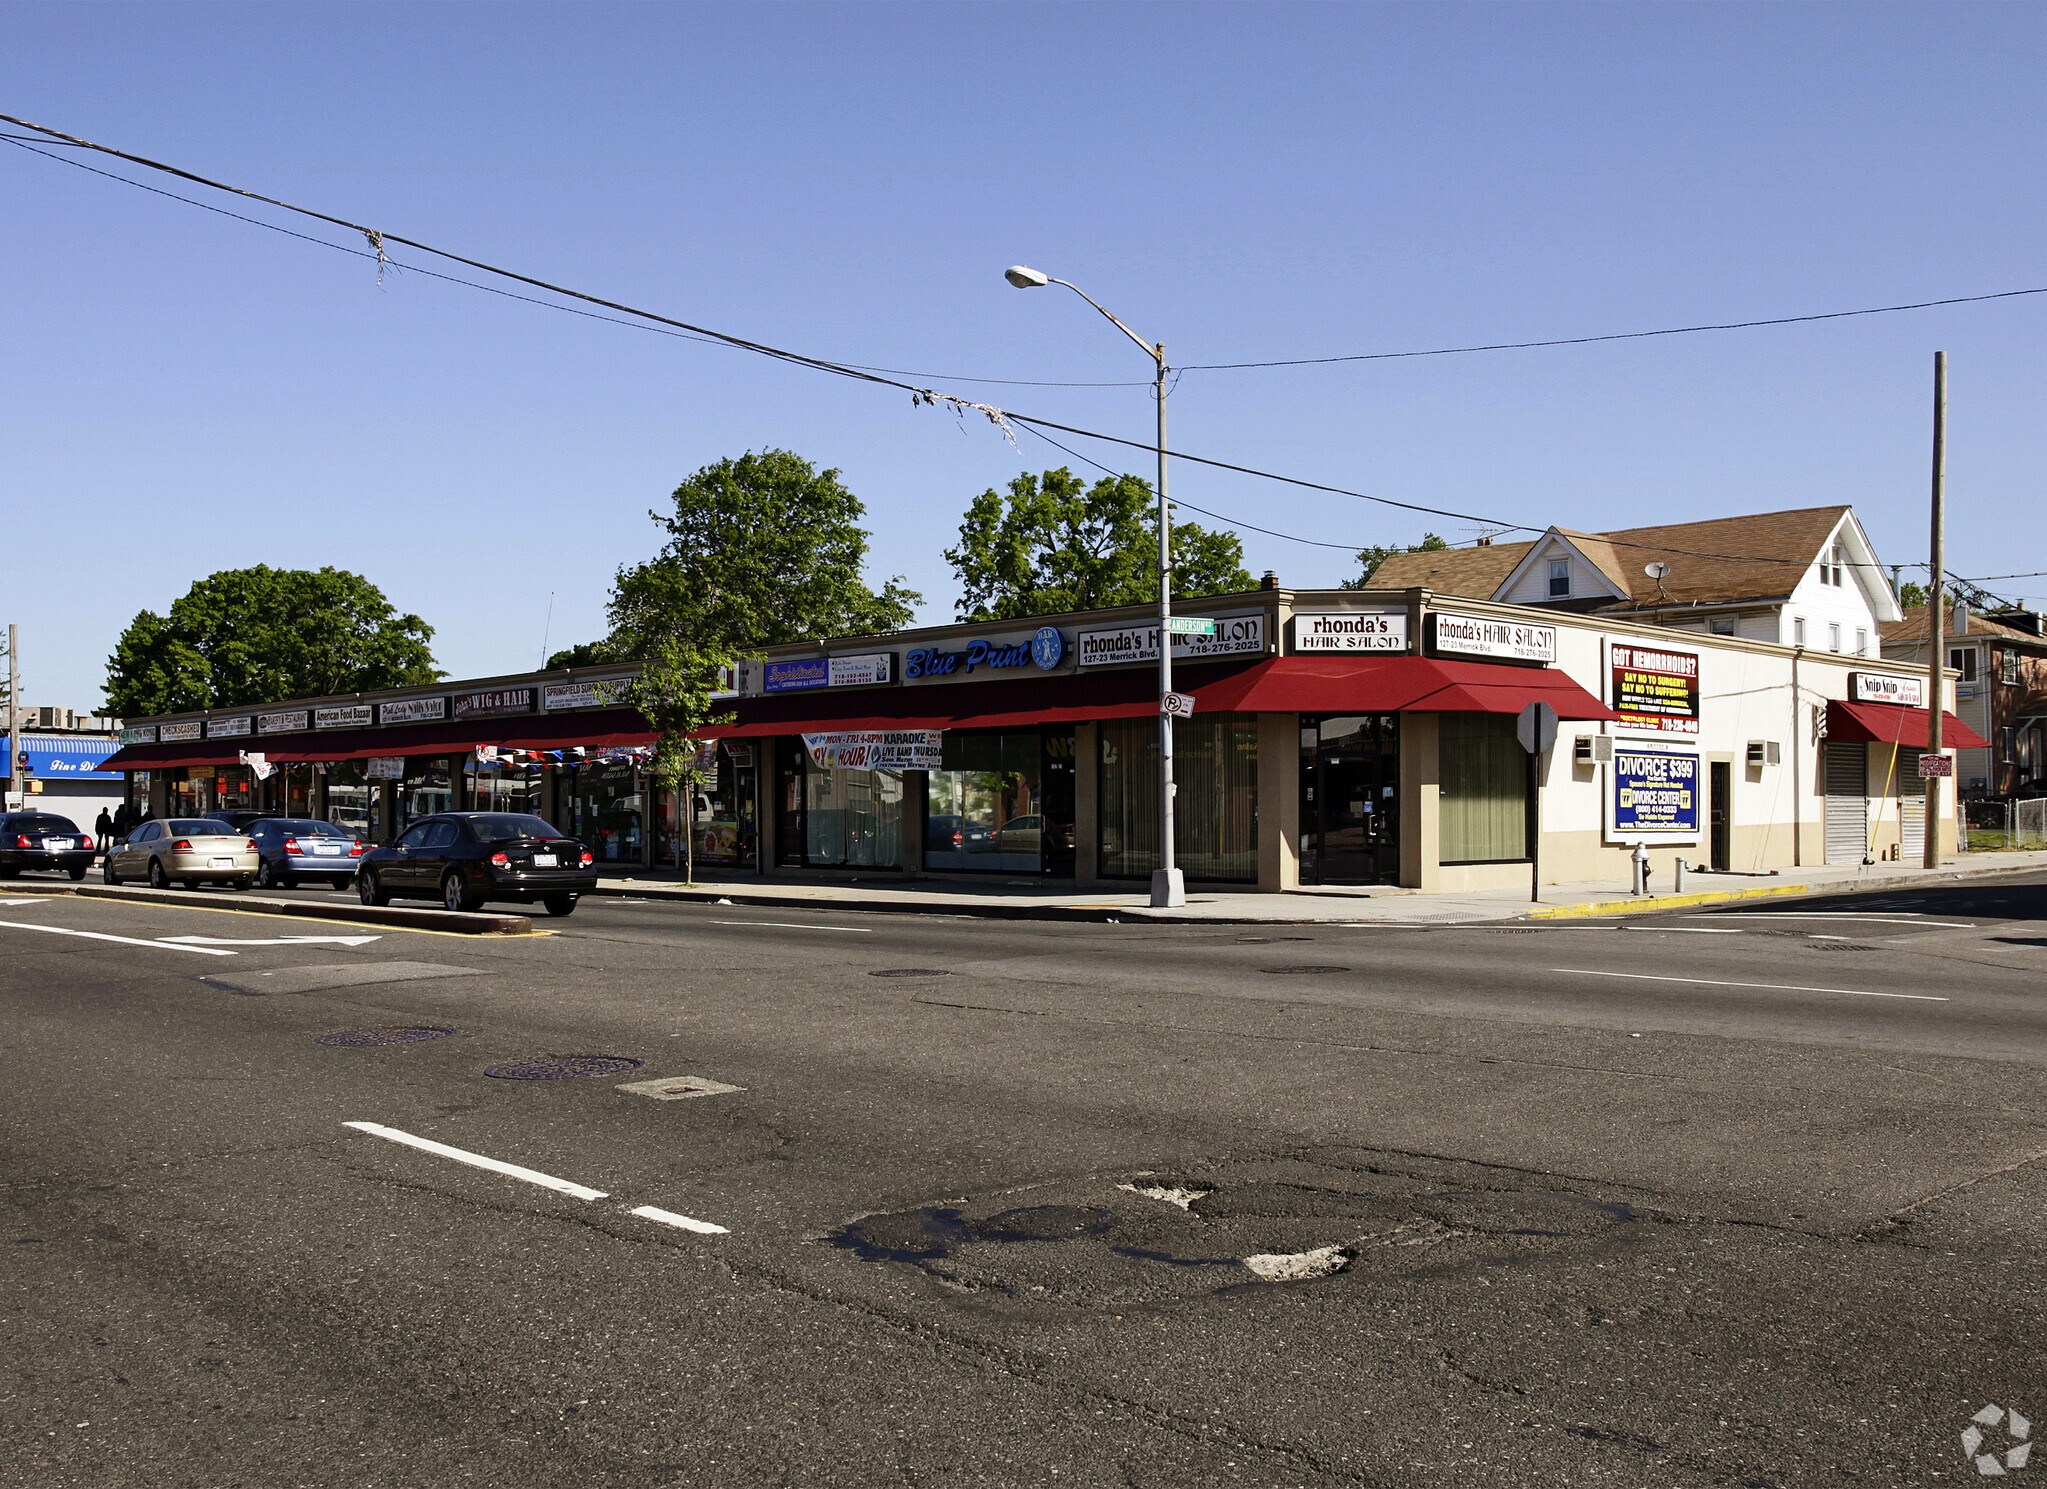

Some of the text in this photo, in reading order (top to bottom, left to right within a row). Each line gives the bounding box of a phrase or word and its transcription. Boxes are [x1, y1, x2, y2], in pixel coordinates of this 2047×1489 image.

[1172, 620, 1205, 632] ANDERSON
[1313, 616, 1388, 633] rhonda's
[1037, 630, 1053, 640] BAR
[1303, 636, 1399, 648] HAIR SALON
[1439, 618, 1552, 649] rhonda's HAIR SALON
[1083, 631, 1142, 654] rhonda's
[1440, 640, 1458, 649] 127-23
[1459, 641, 1478, 651] Merrick
[1514, 647, 1551, 659] 718-276-2025
[905, 639, 1031, 679] Blue Print
[1083, 640, 1260, 663] 127-23 Merrick Blvd. 718-276-2025
[1612, 647, 1697, 675] GOT HEMORRHOIDS?
[1624, 672, 1687, 688] SAY NO TO SURGERY!
[1865, 676, 1881, 692] Snip
[1882, 679, 1897, 694] Snip
[546, 683, 580, 697] SPRINGFIELD
[1621, 683, 1689, 699] SAY NO TO SUFFERING!
[471, 693, 493, 709] WIG
[494, 694, 502, 706] &
[503, 690, 530, 706] HAIR
[316, 707, 371, 721] American Food Bazaar
[884, 732, 927, 744] KARAOKE
[838, 745, 872, 767] HOUR!
[882, 747, 895, 757] LIVE
[896, 746, 913, 756] BAND
[50, 759, 77, 772] Fine
[1619, 756, 1693, 779] DIVORCE $399
[1633, 790, 1657, 804] DIVORCE
